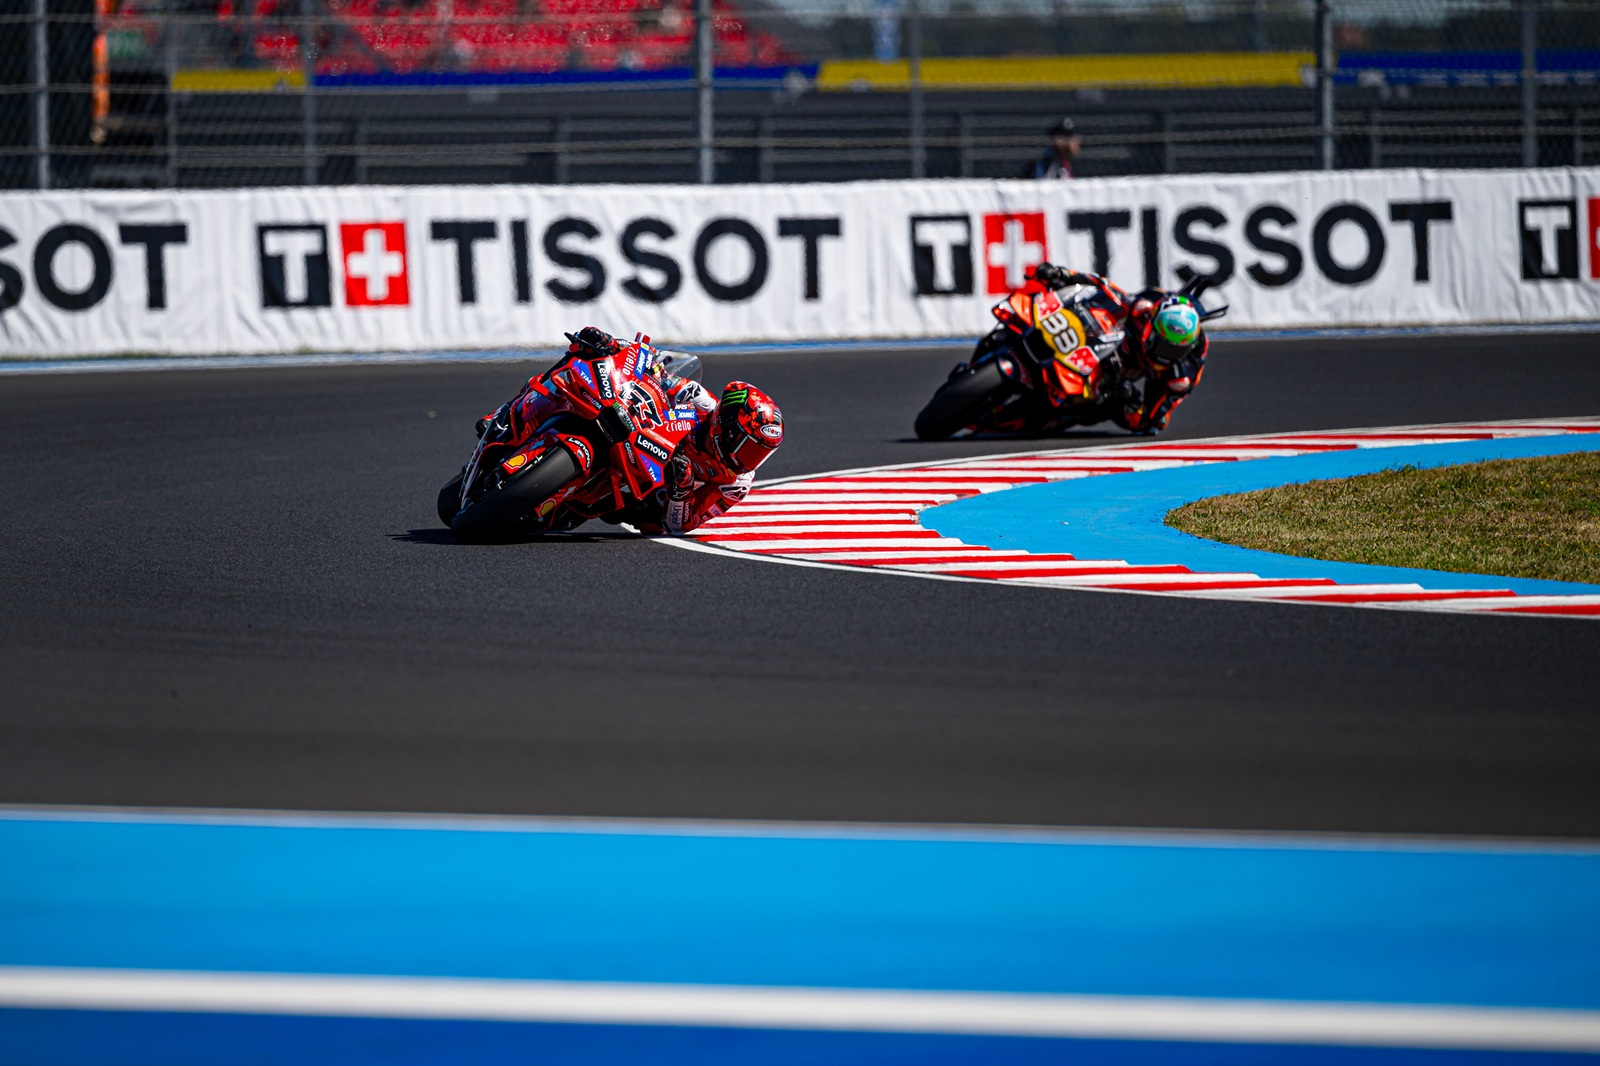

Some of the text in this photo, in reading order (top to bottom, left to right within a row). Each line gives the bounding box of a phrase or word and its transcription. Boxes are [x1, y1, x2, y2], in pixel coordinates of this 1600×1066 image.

[430, 216, 842, 306] TISSOT
[1067, 201, 1452, 293] TISSOT
[1042, 312, 1079, 354] 33
[580, 371, 592, 385] TIM
[597, 362, 613, 398] Lenovo
[568, 437, 590, 468] Lenovo
[637, 434, 668, 460] Lenovo
[670, 505, 683, 525] Unipol
